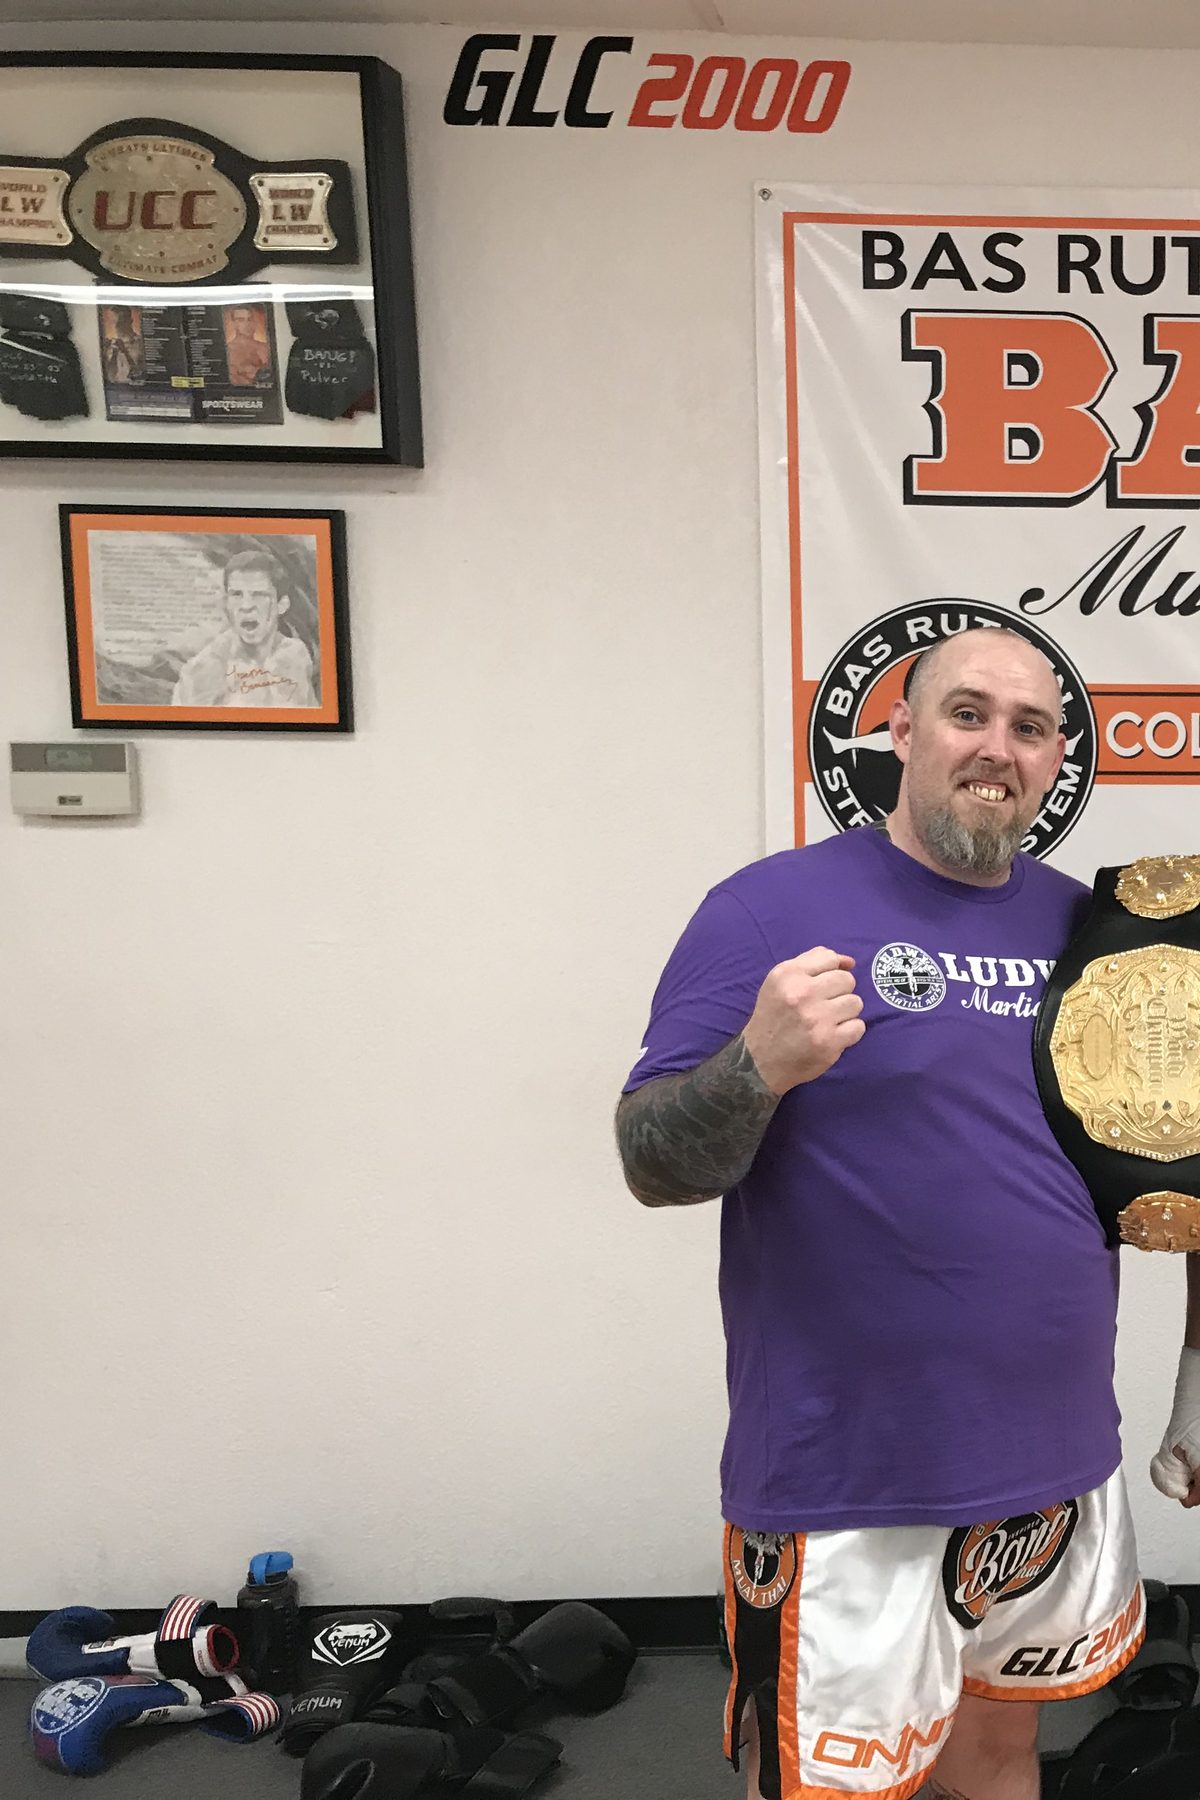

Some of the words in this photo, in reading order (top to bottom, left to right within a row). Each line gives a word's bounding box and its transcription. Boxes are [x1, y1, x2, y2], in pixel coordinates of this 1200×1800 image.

[443, 34, 634, 128] GLC
[627, 53, 851, 133] 2000
[94, 190, 216, 231] UCC
[862, 230, 1026, 293] BAS
[825, 634, 893, 717] BAS
[733, 1560, 758, 1602] MUAY
[761, 1576, 786, 1604] THAI
[330, 1638, 370, 1649] VENUM
[1000, 1633, 1089, 1677] GLC
[290, 1696, 342, 1715] VENUM
